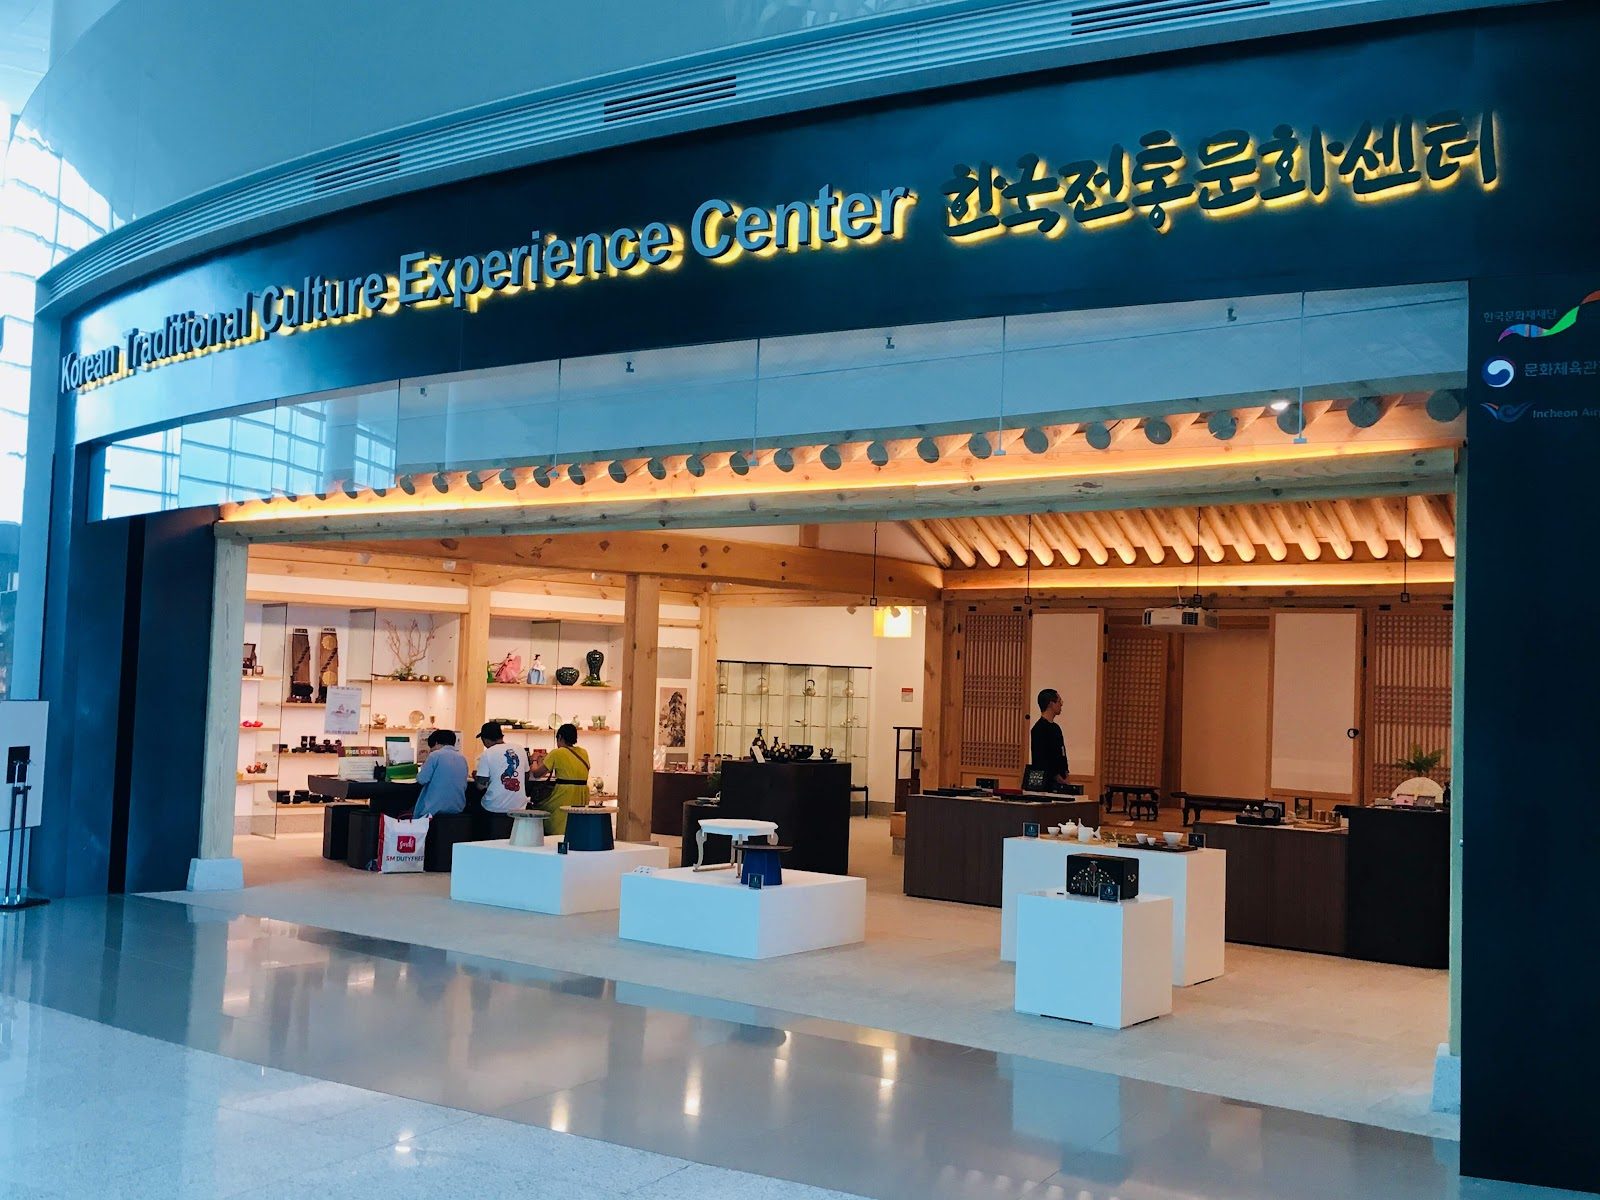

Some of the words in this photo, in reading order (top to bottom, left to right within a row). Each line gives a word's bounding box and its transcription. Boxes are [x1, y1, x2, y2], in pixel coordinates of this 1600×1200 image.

[60, 346, 120, 393] Korean
[122, 291, 253, 370] Traditional
[257, 271, 388, 333] Culture
[398, 219, 674, 309] Experience
[690, 183, 912, 259] Center
[1524, 361, 1600, 377] 문화체육관
[1532, 408, 1578, 419] Incheon
[1582, 407, 1600, 419] Air
